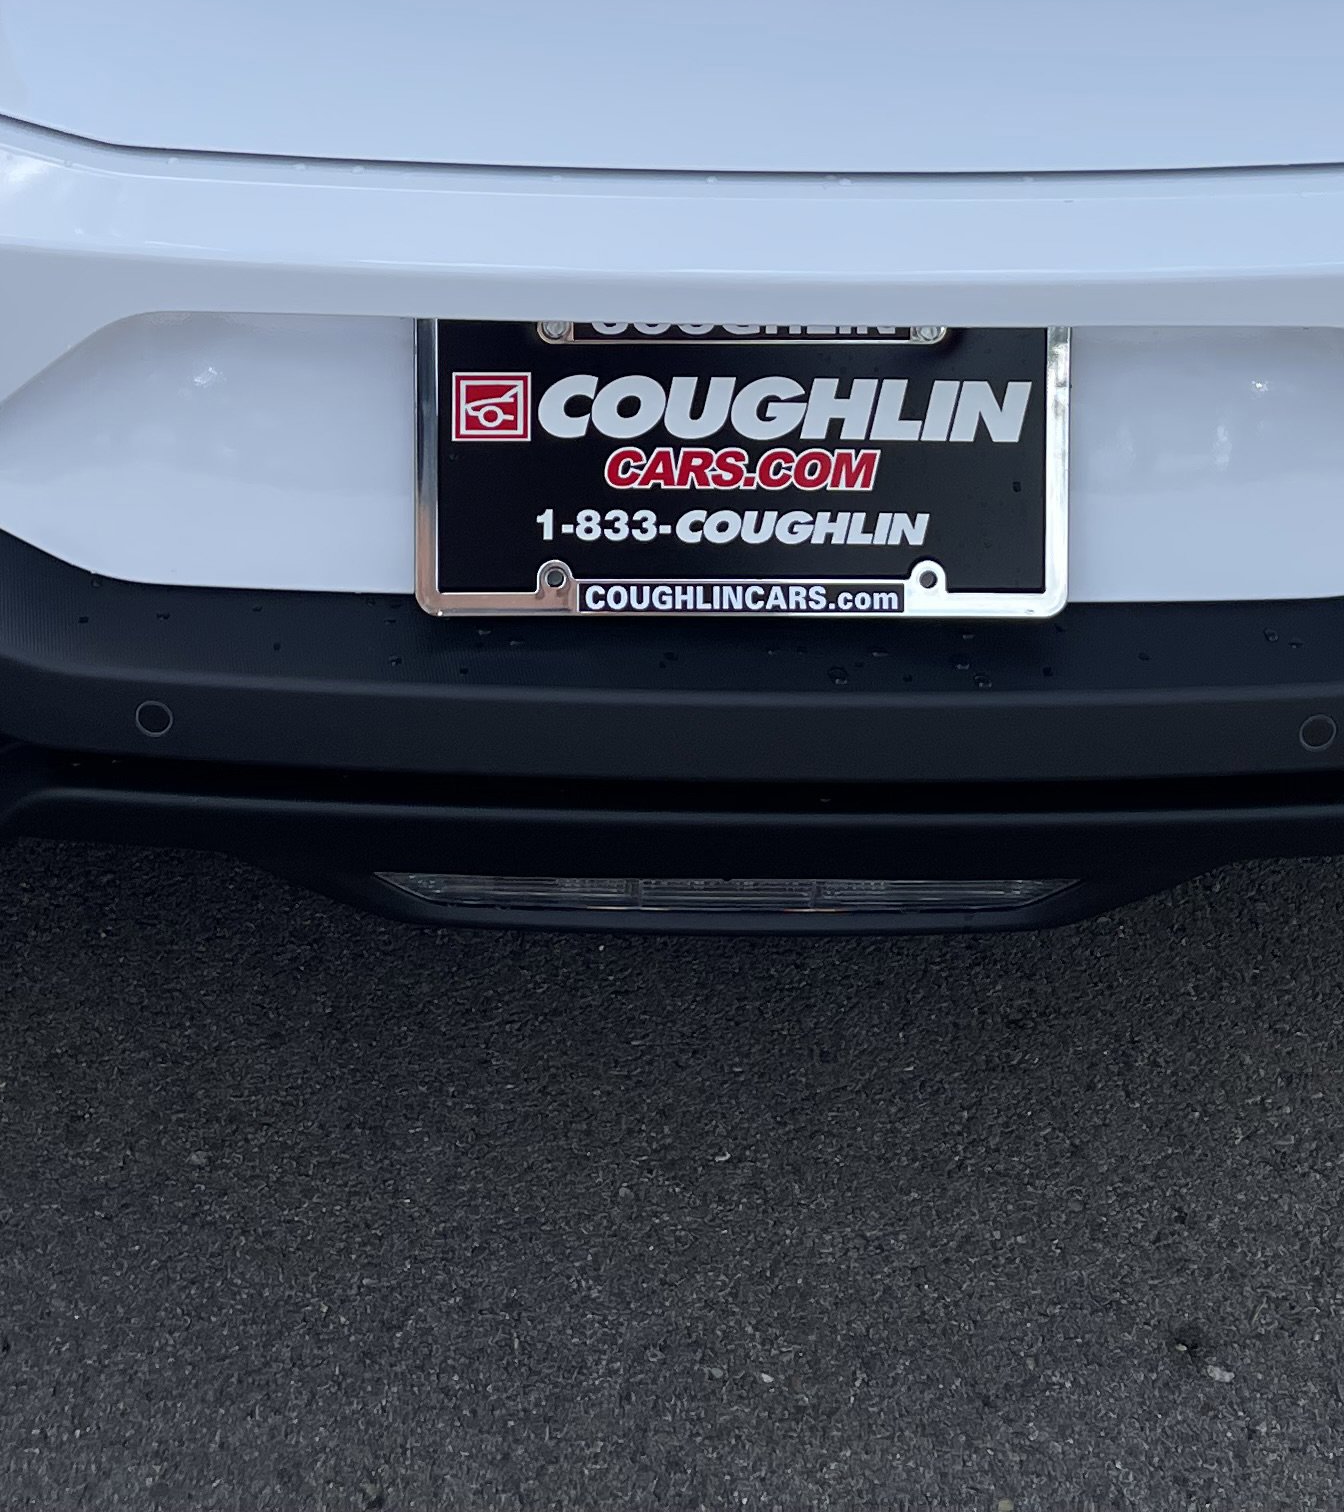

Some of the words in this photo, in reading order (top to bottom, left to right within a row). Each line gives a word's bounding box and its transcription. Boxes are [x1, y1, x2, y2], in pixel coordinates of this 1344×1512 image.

[537, 374, 1032, 443] COUGHLIN
[604, 447, 879, 491] CARS.COM
[536, 508, 930, 546] 1-833-COUGHLIN
[585, 585, 898, 610] COUGHLINCARS.com
